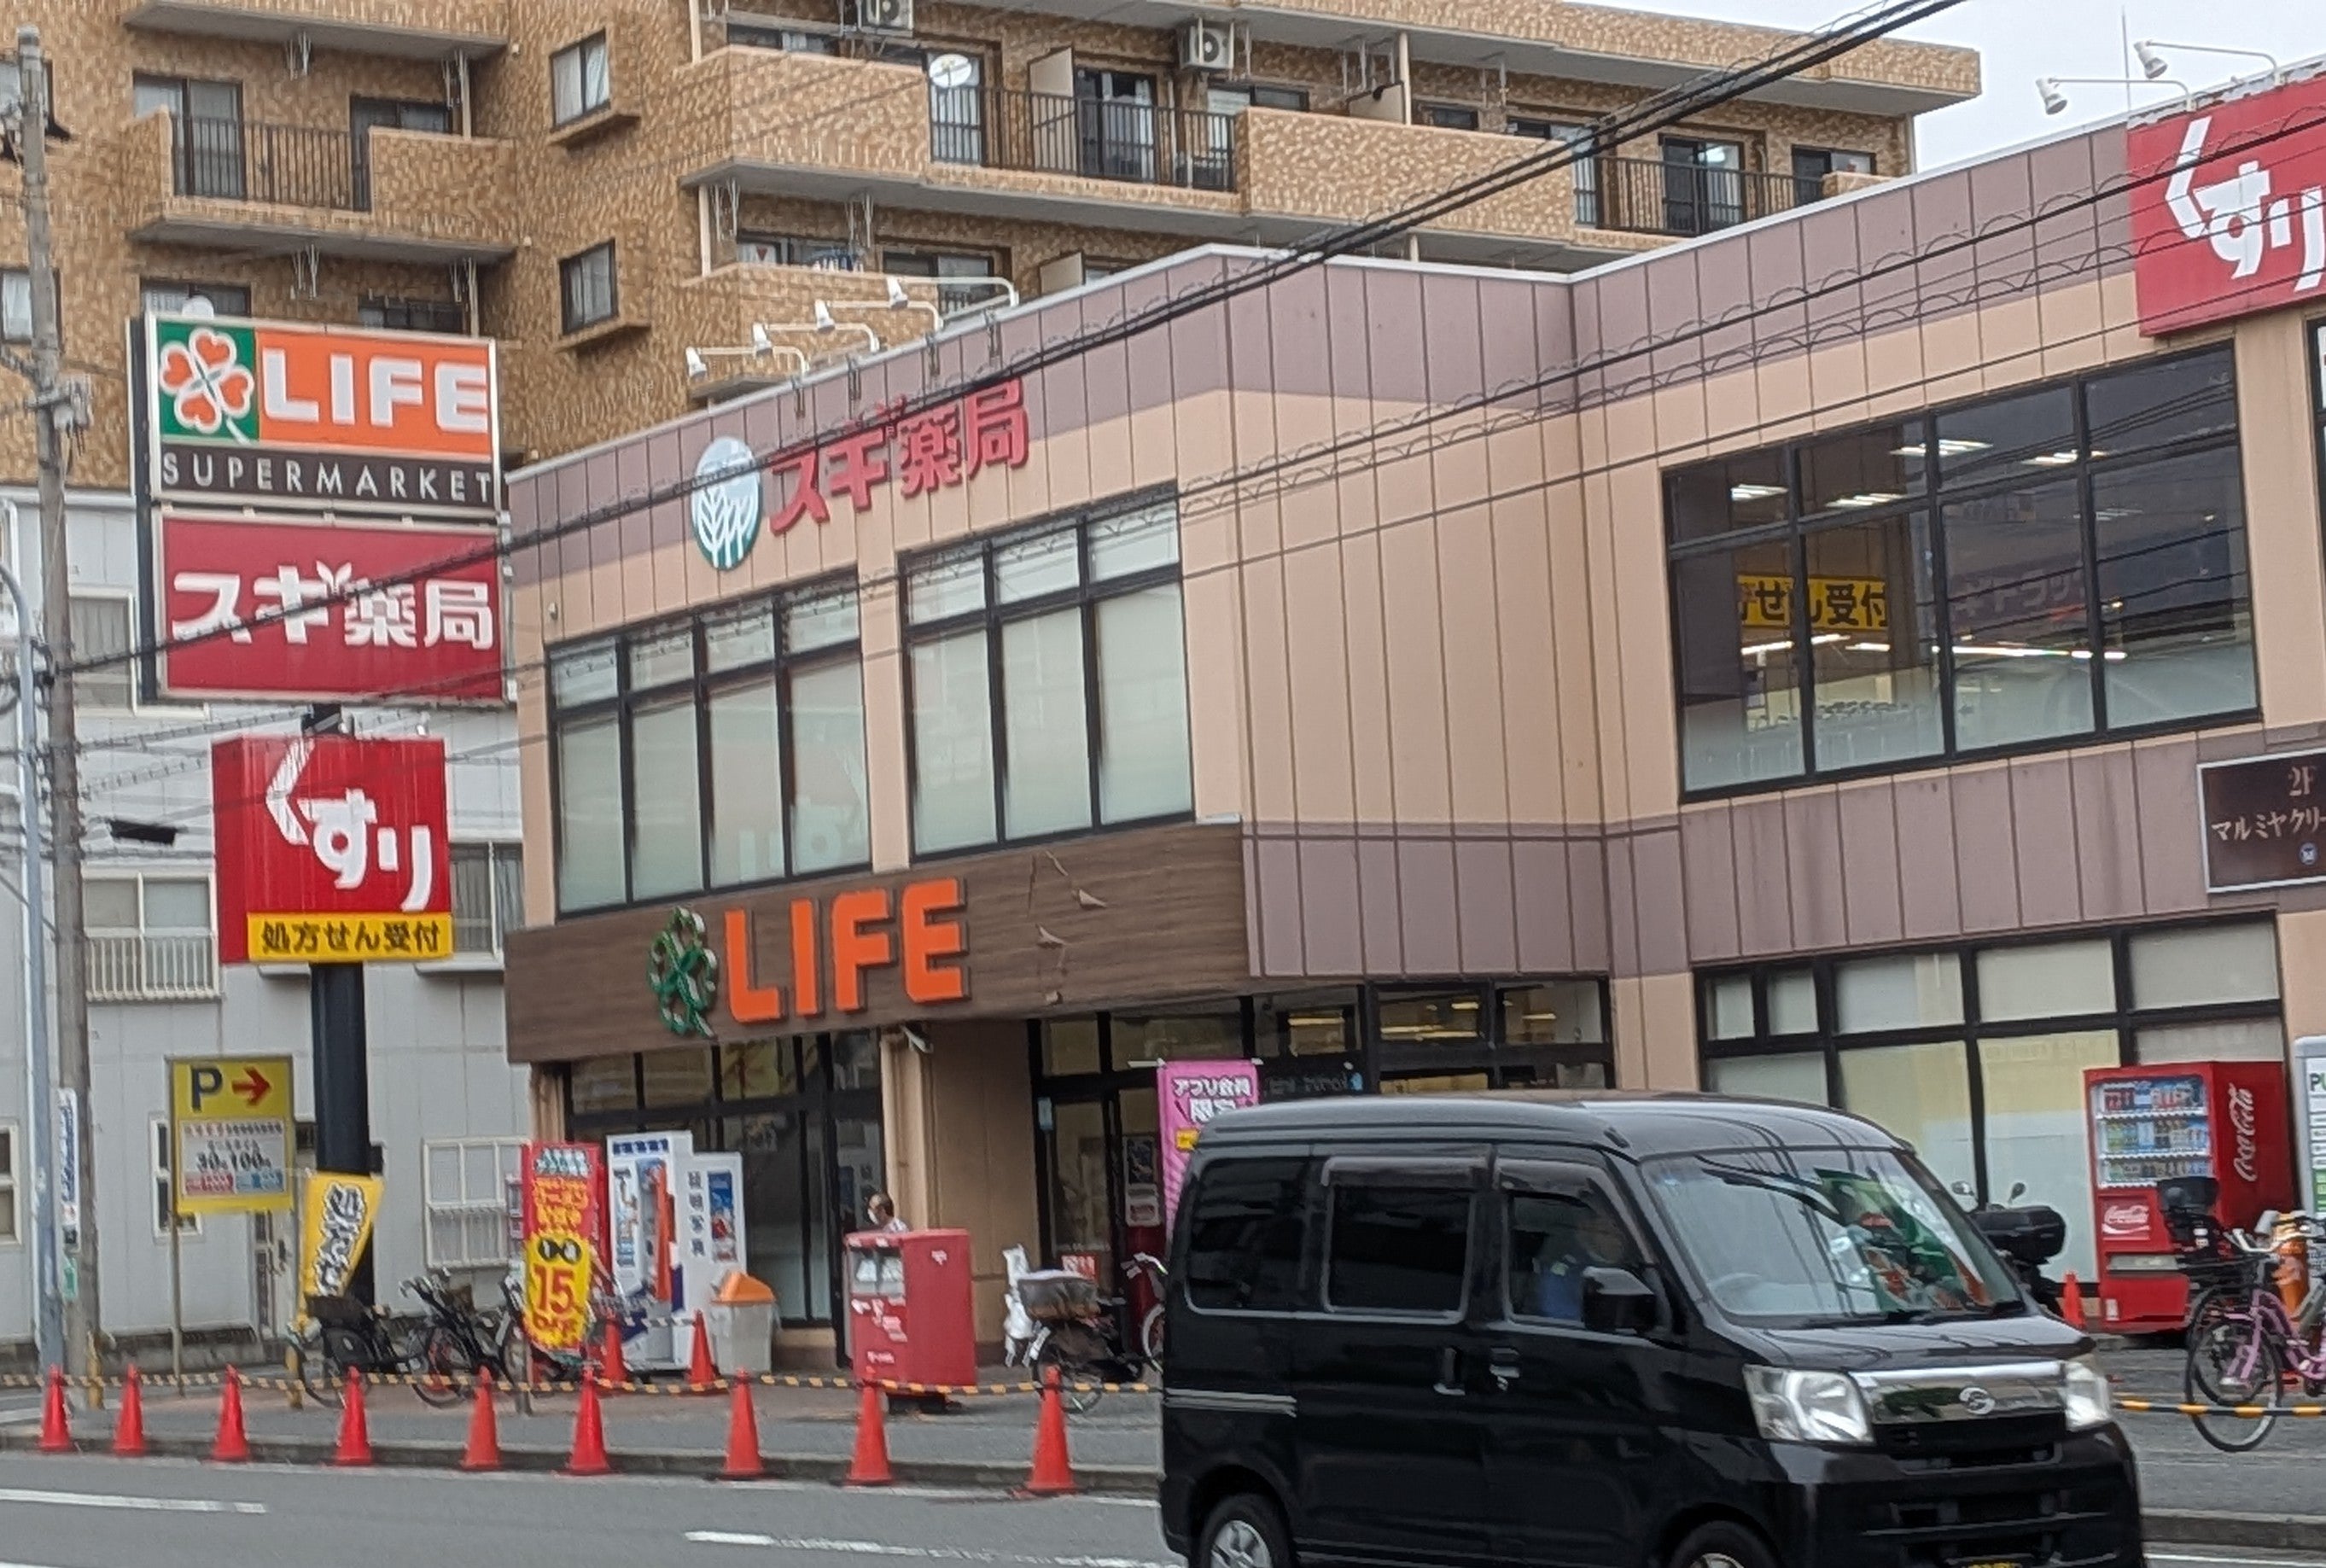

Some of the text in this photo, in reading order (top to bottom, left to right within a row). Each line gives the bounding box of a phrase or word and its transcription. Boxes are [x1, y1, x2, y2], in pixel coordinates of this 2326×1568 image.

[2165, 115, 2325, 292] くすり
[261, 347, 487, 433] LIFE
[161, 452, 493, 503] SUPERMARKET
[770, 378, 1029, 535] スギ薬局
[172, 560, 494, 650] スギ薬局
[265, 737, 433, 912] くすり
[260, 919, 442, 954] 処方せん受付
[724, 876, 971, 1023] LIFE
[190, 1067, 223, 1112] P
